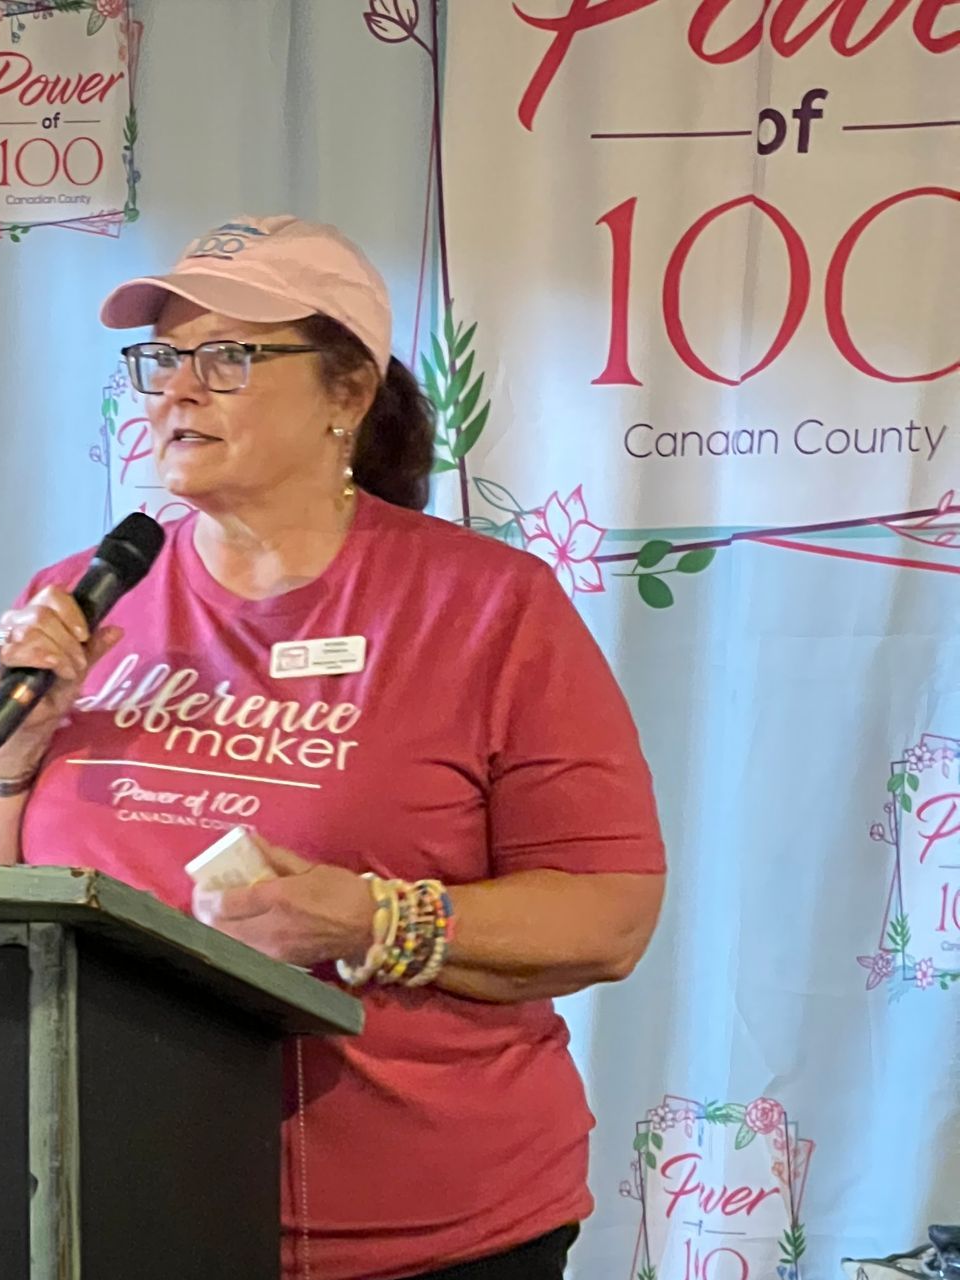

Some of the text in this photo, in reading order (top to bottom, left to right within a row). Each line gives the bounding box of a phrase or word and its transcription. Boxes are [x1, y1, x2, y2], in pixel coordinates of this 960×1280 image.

[41, 112, 61, 129] of
[757, 88, 828, 155] of
[5, 194, 91, 205] Canadian County
[591, 186, 960, 387] 100
[794, 419, 947, 461] County
[75, 653, 361, 734] difference
[165, 725, 358, 770] maker
[109, 778, 260, 817] Power of 100
[117, 809, 196, 826] CANADIAN
